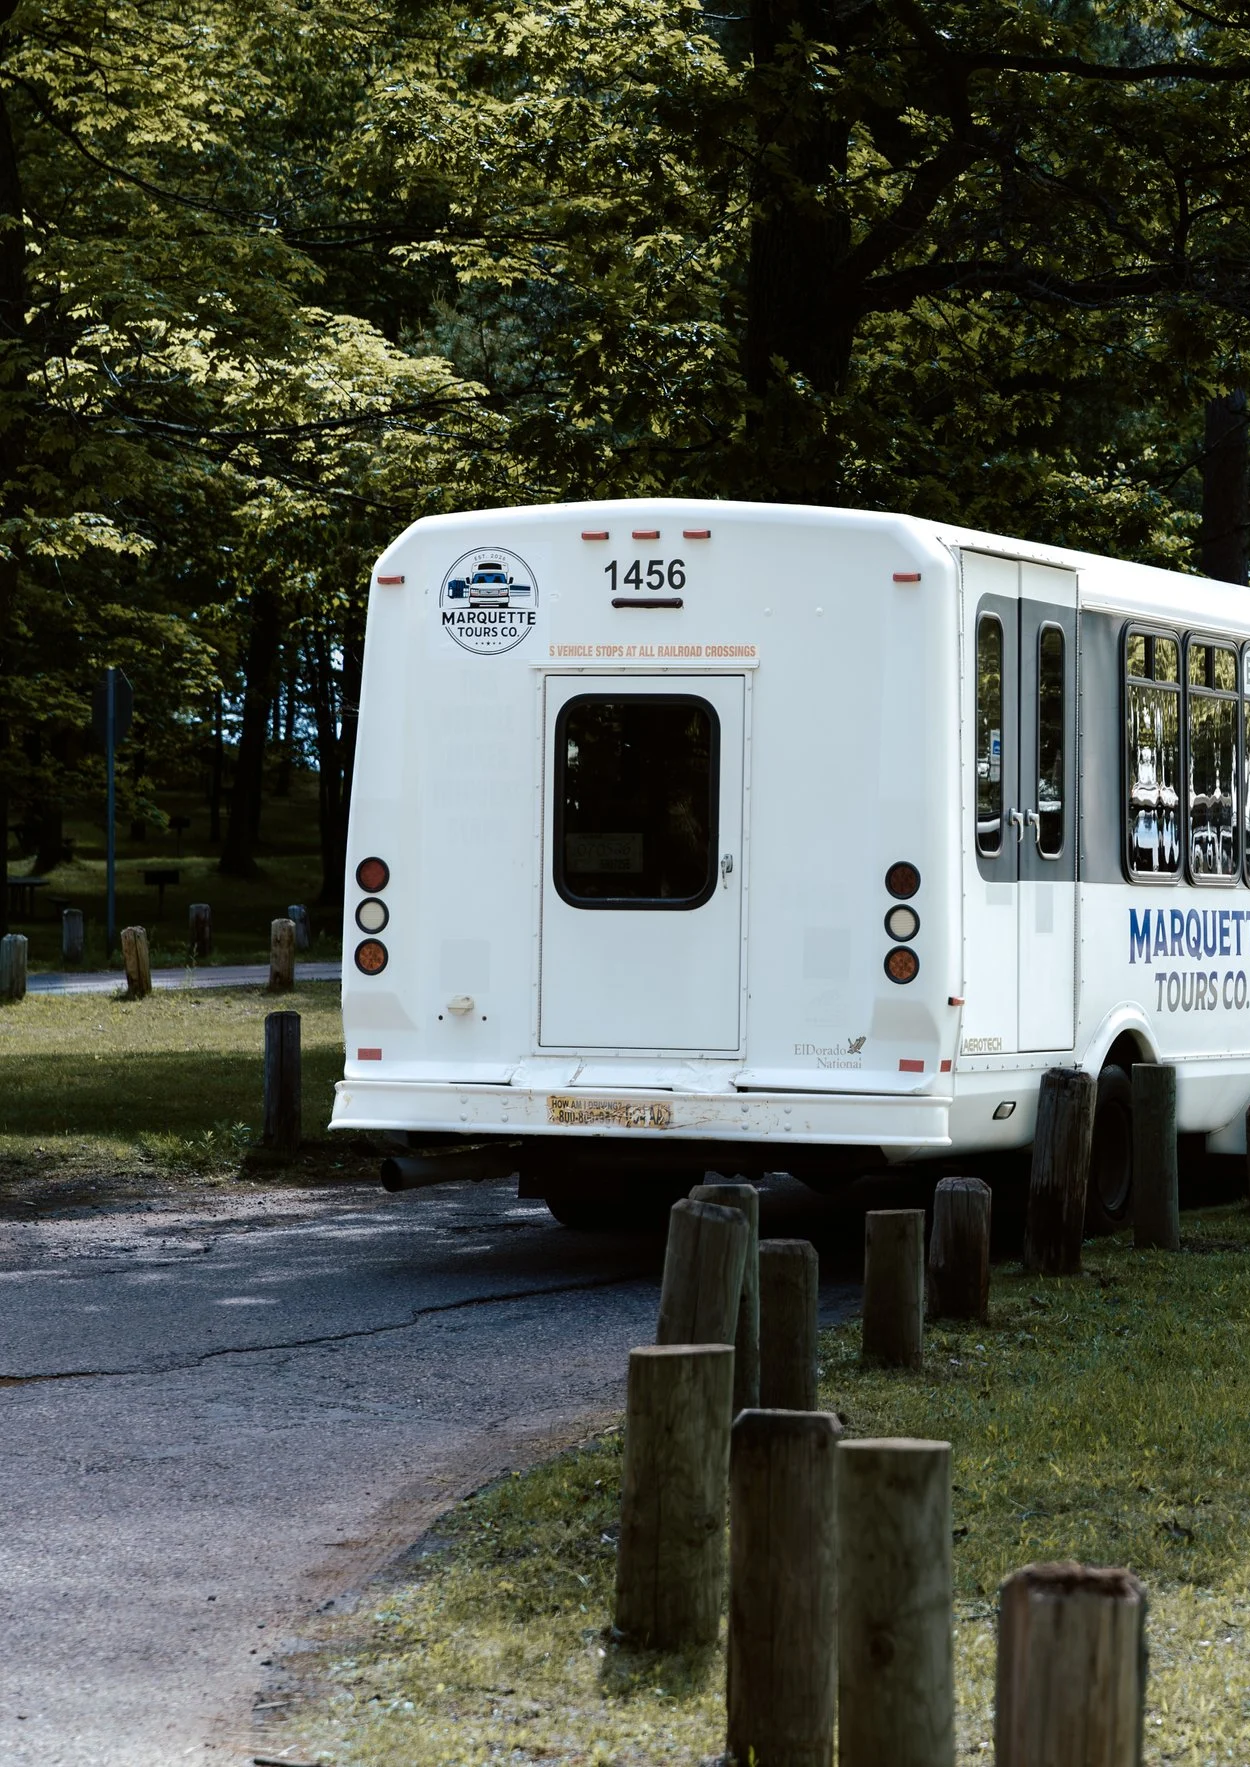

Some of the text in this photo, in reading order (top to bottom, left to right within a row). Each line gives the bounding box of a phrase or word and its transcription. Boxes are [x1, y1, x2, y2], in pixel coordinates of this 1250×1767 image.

[605, 559, 686, 590] 1456
[442, 611, 536, 626] MARQUETTE
[457, 627, 520, 637] TOURS CO.
[557, 645, 593, 657] VEHICLE
[596, 645, 624, 657] STOPS
[626, 645, 637, 657] AT
[639, 645, 655, 657] ALL
[658, 645, 702, 657] RAILROAD
[705, 645, 756, 657] CROSSINGS
[1155, 970, 1250, 1012] TOURS CO.
[794, 1043, 847, 1056] ElDorado
[963, 1038, 1002, 1052] AEROTECH
[552, 1100, 569, 1108] HOW
[571, 1100, 582, 1109] AM
